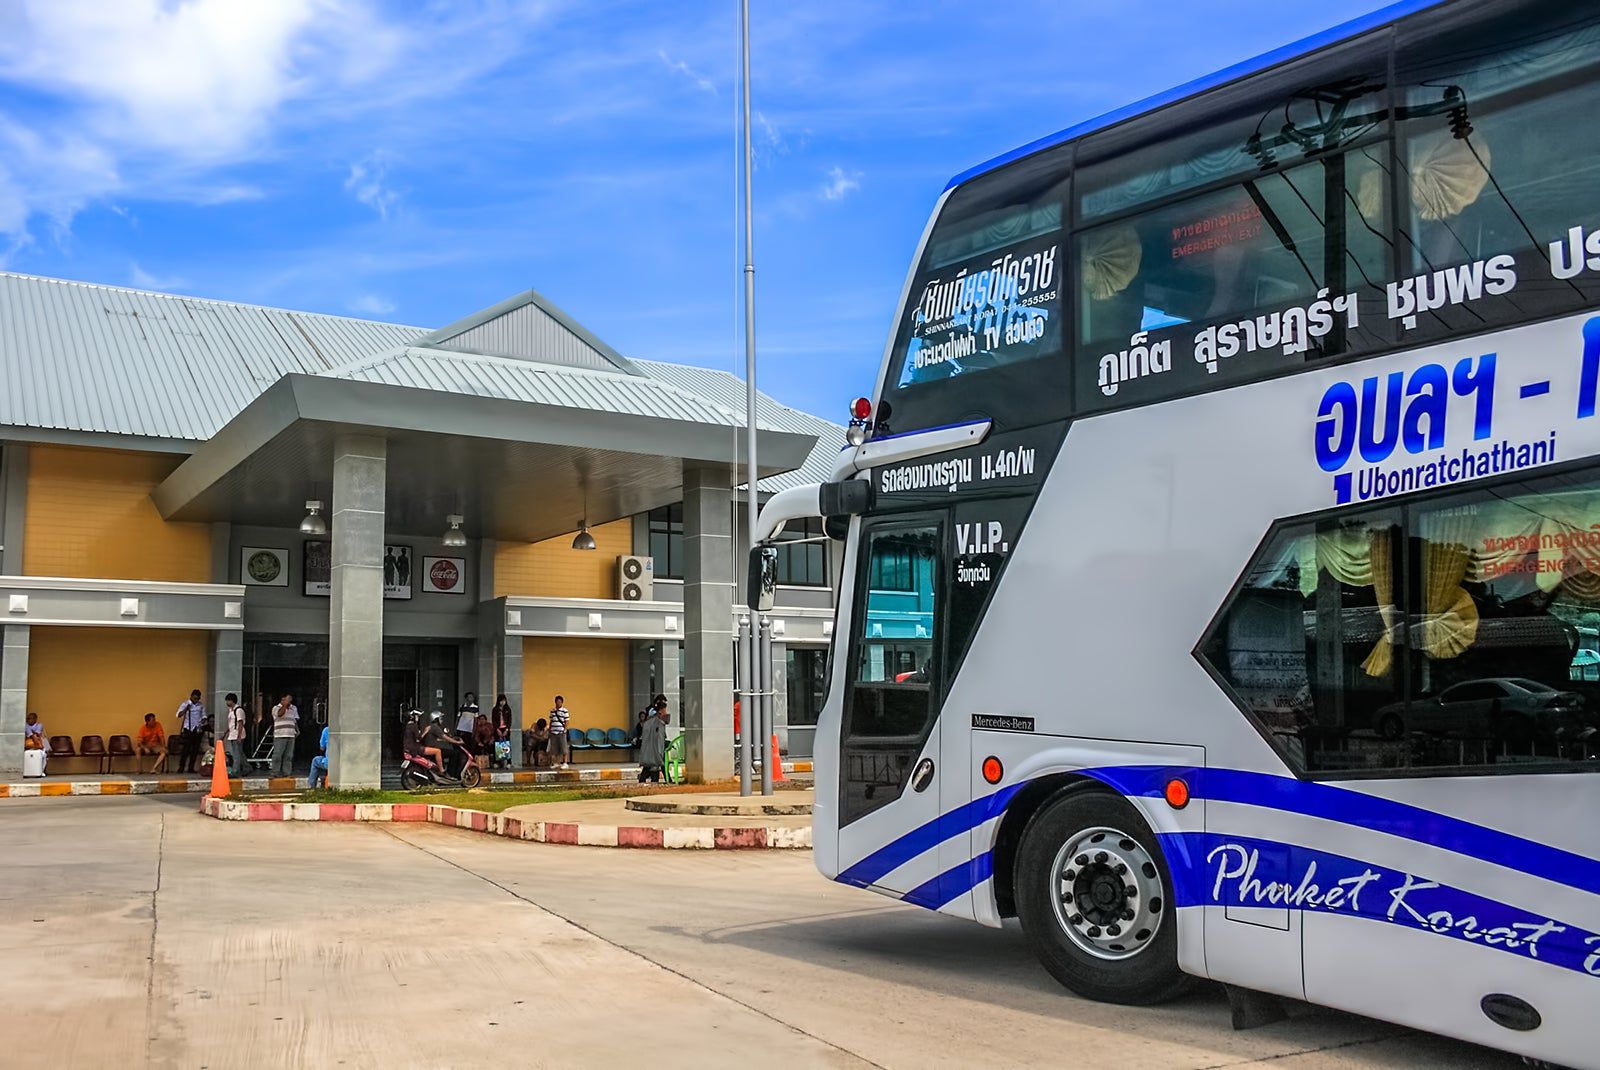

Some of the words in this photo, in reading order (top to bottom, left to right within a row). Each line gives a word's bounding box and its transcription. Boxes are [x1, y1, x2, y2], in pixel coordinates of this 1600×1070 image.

[984, 325, 1000, 351] TV
[1098, 329, 1171, 397] ภูเก็ต
[1386, 254, 1517, 330] ชุมพร
[1314, 352, 1497, 505] อุบลฯ
[1358, 431, 1556, 501] Ubonratchathani
[955, 520, 1009, 555] V.I.P.
[973, 715, 1033, 730] Mercedes-Benz
[1206, 843, 1381, 911] Phuket
[1386, 873, 1566, 957] Korat
